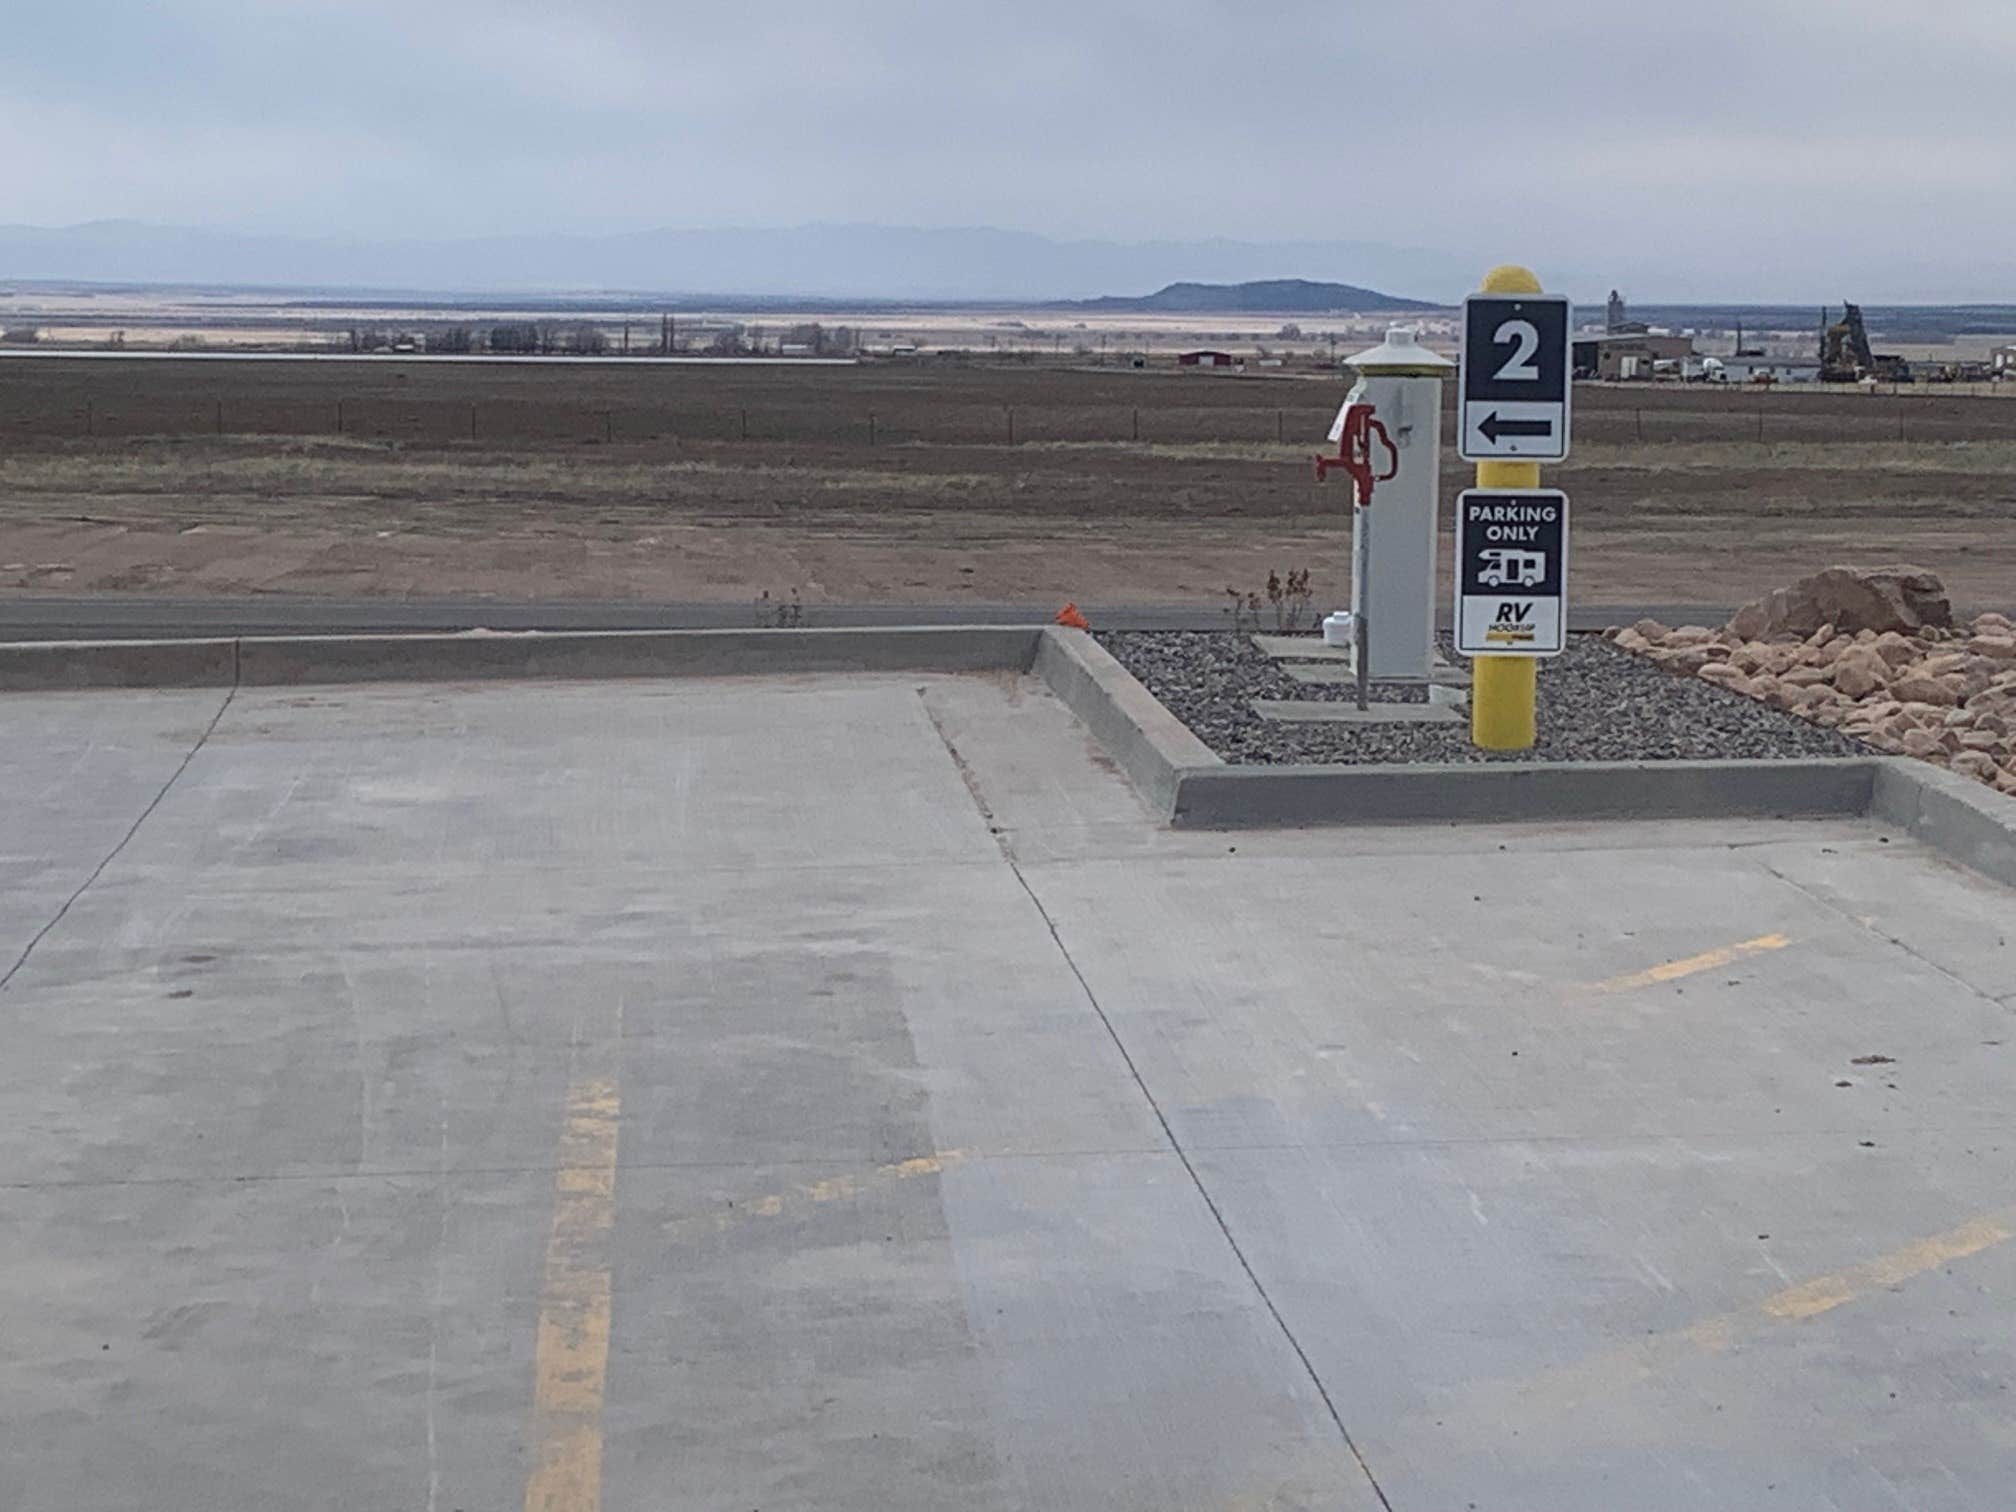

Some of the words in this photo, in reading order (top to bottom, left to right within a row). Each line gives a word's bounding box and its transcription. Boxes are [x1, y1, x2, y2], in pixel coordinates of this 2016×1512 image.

[1492, 319, 1539, 380] 2
[1469, 506, 1556, 522] PARKING
[1486, 526, 1539, 541] ONLY
[1496, 602, 1533, 622] RV
